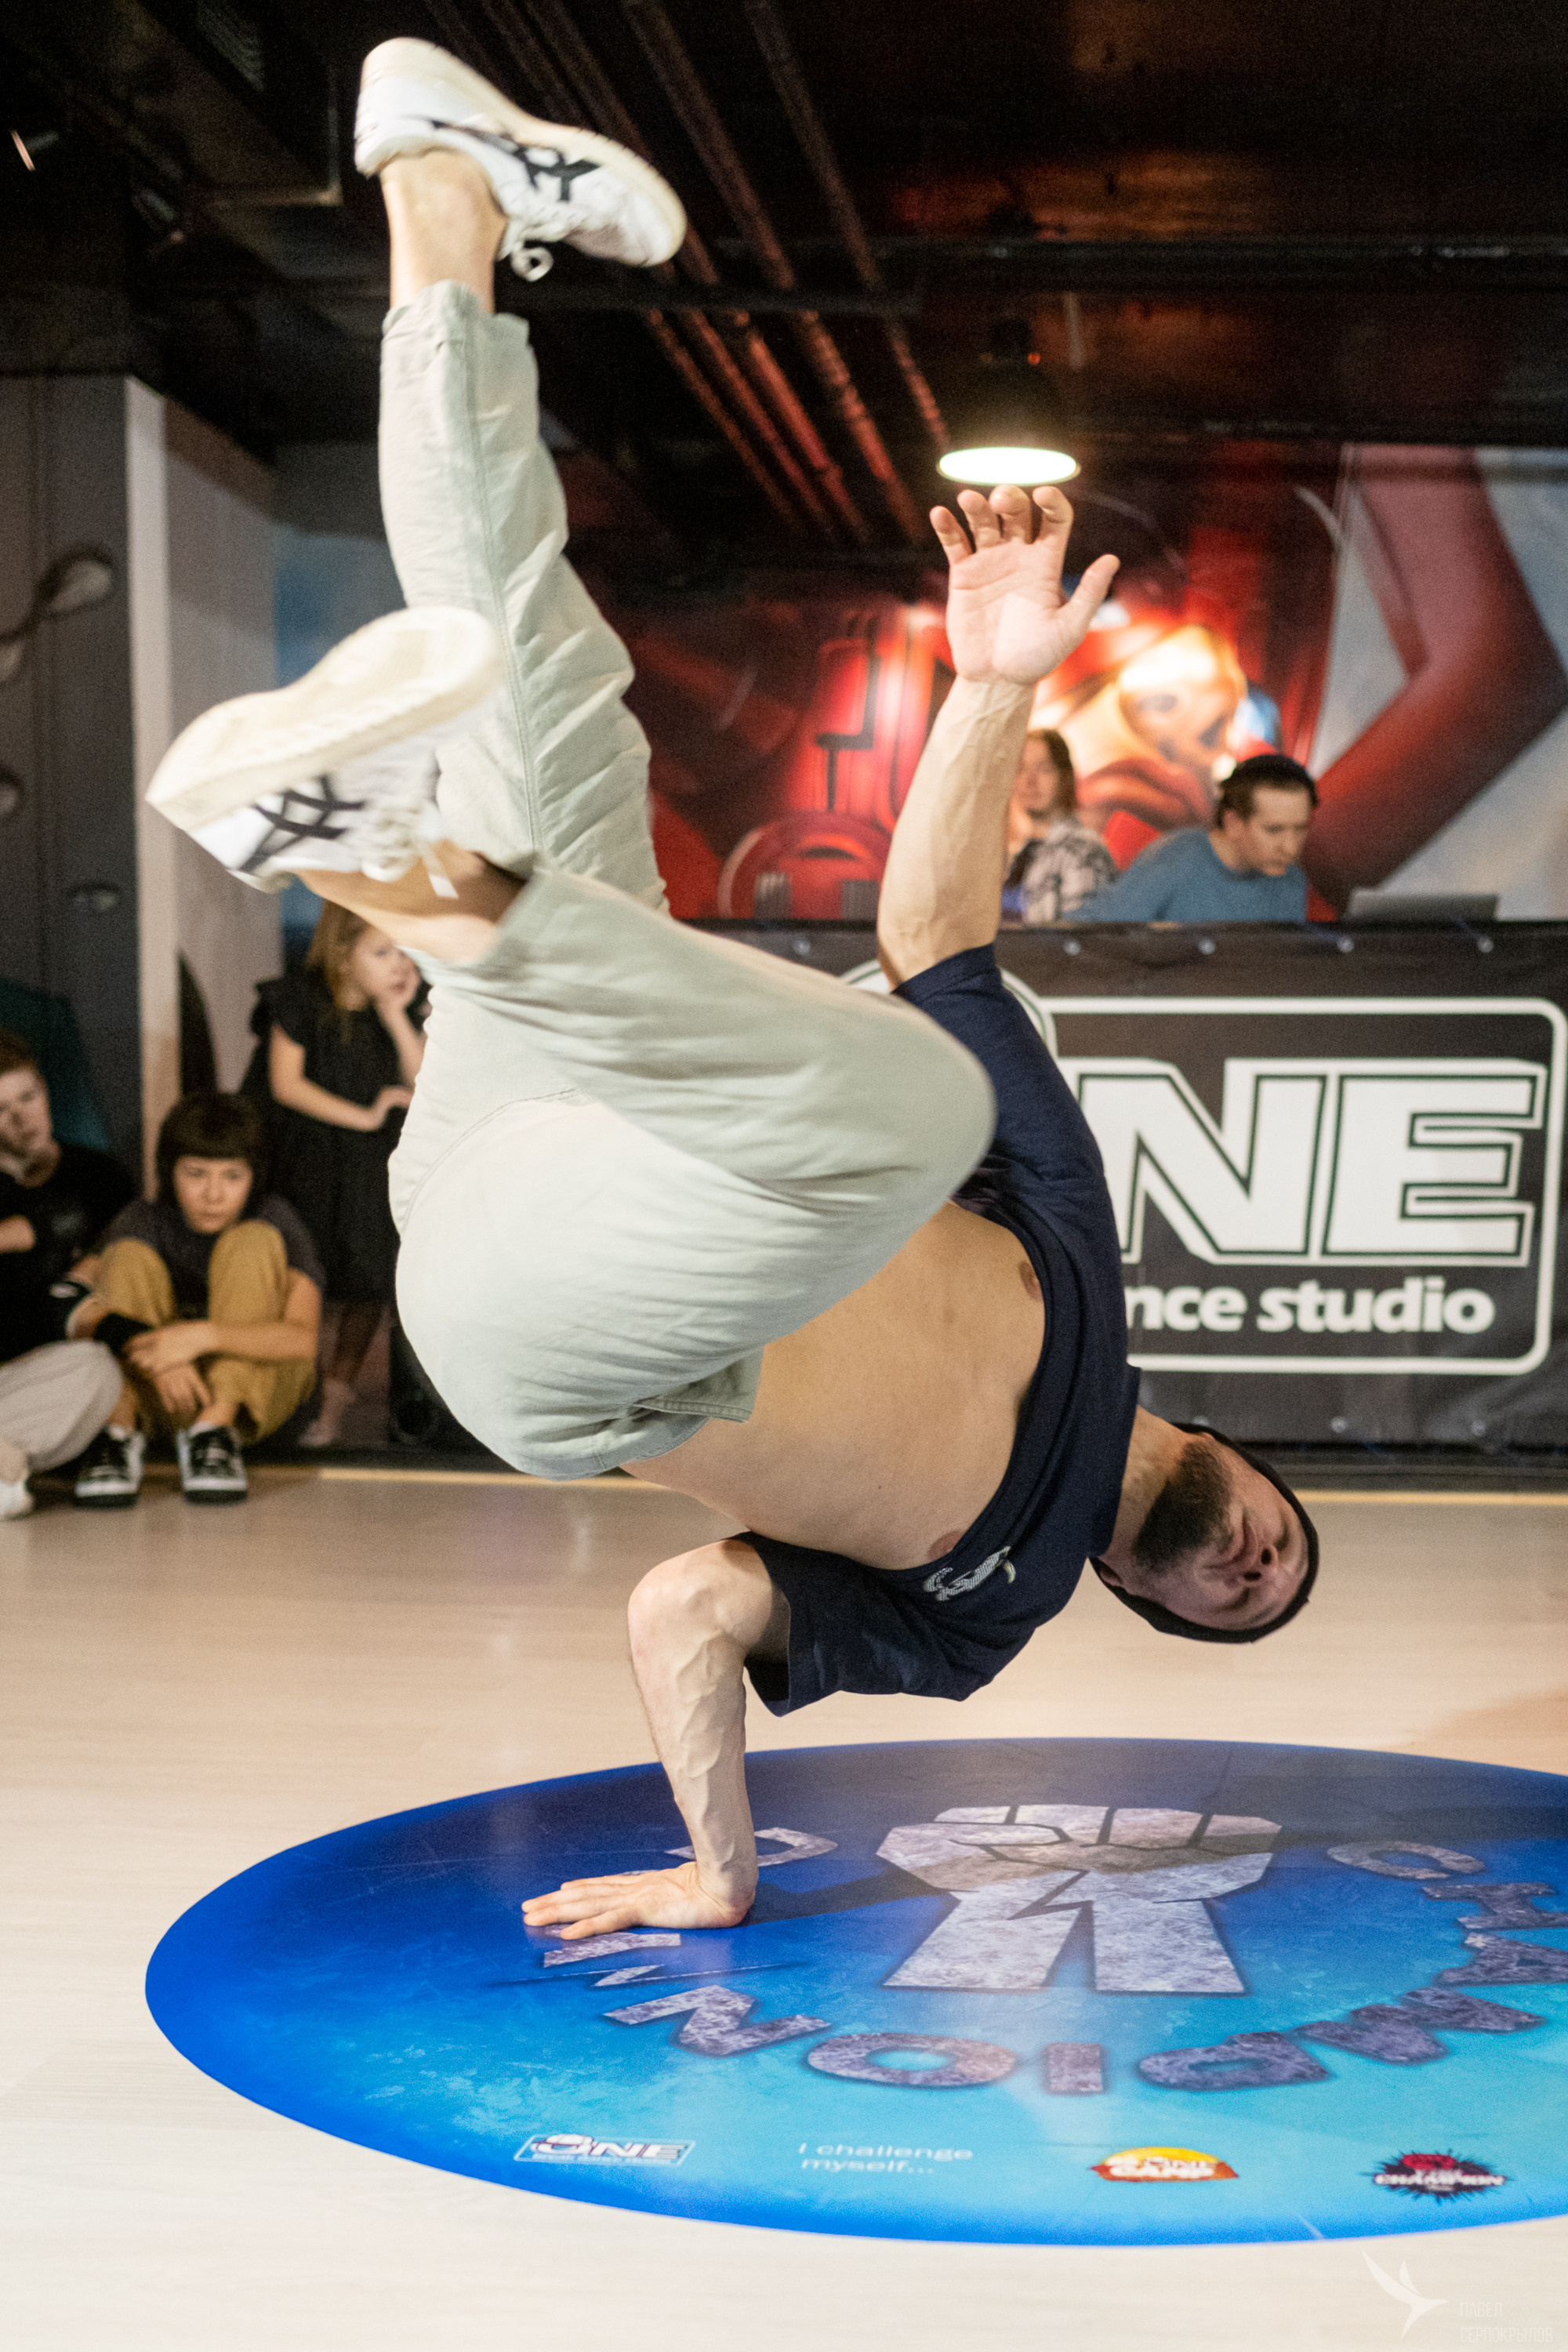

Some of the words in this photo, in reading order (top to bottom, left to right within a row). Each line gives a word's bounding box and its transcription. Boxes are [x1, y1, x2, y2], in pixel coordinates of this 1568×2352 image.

[1125, 1285, 1247, 1331] nce
[1257, 1276, 1495, 1333] studio
[798, 2142, 807, 2154] I
[816, 2143, 974, 2161] challenge
